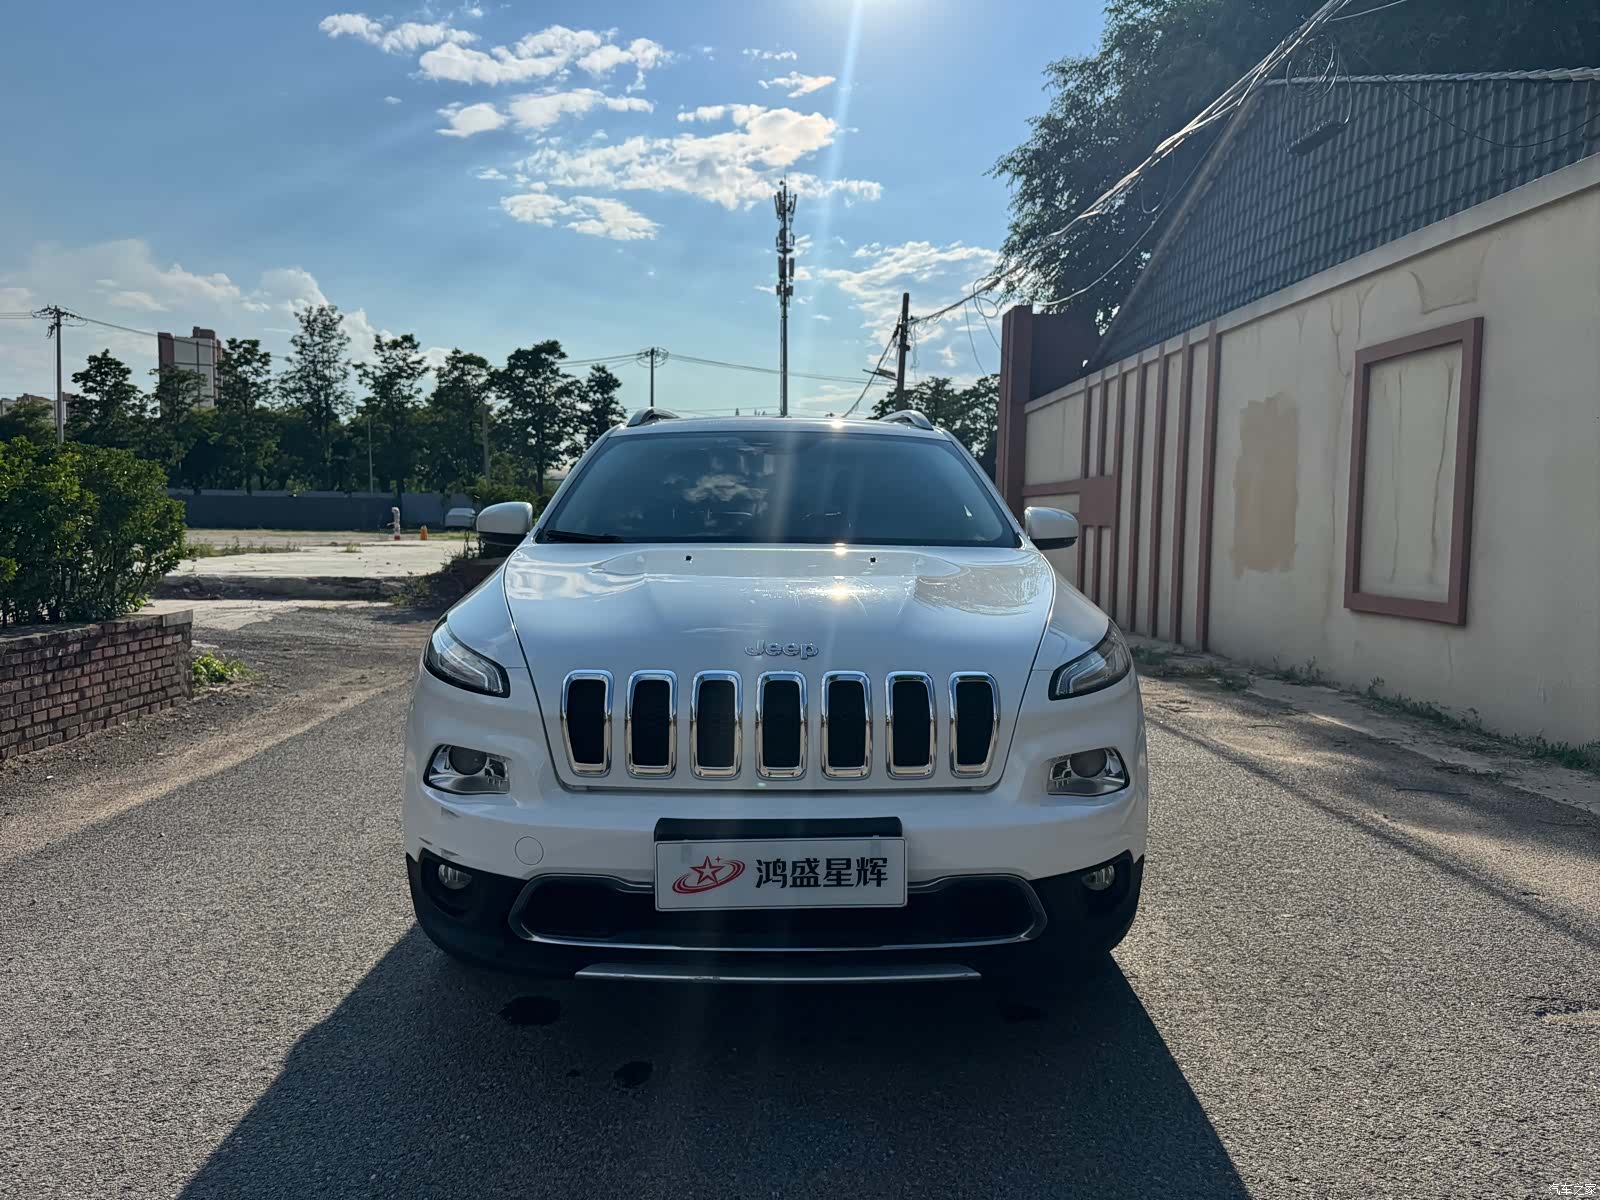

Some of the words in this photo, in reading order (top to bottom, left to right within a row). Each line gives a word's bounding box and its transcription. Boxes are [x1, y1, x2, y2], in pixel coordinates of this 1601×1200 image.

[744, 640, 819, 660] Jeep
[755, 857, 888, 888] 鸿盛星辉
